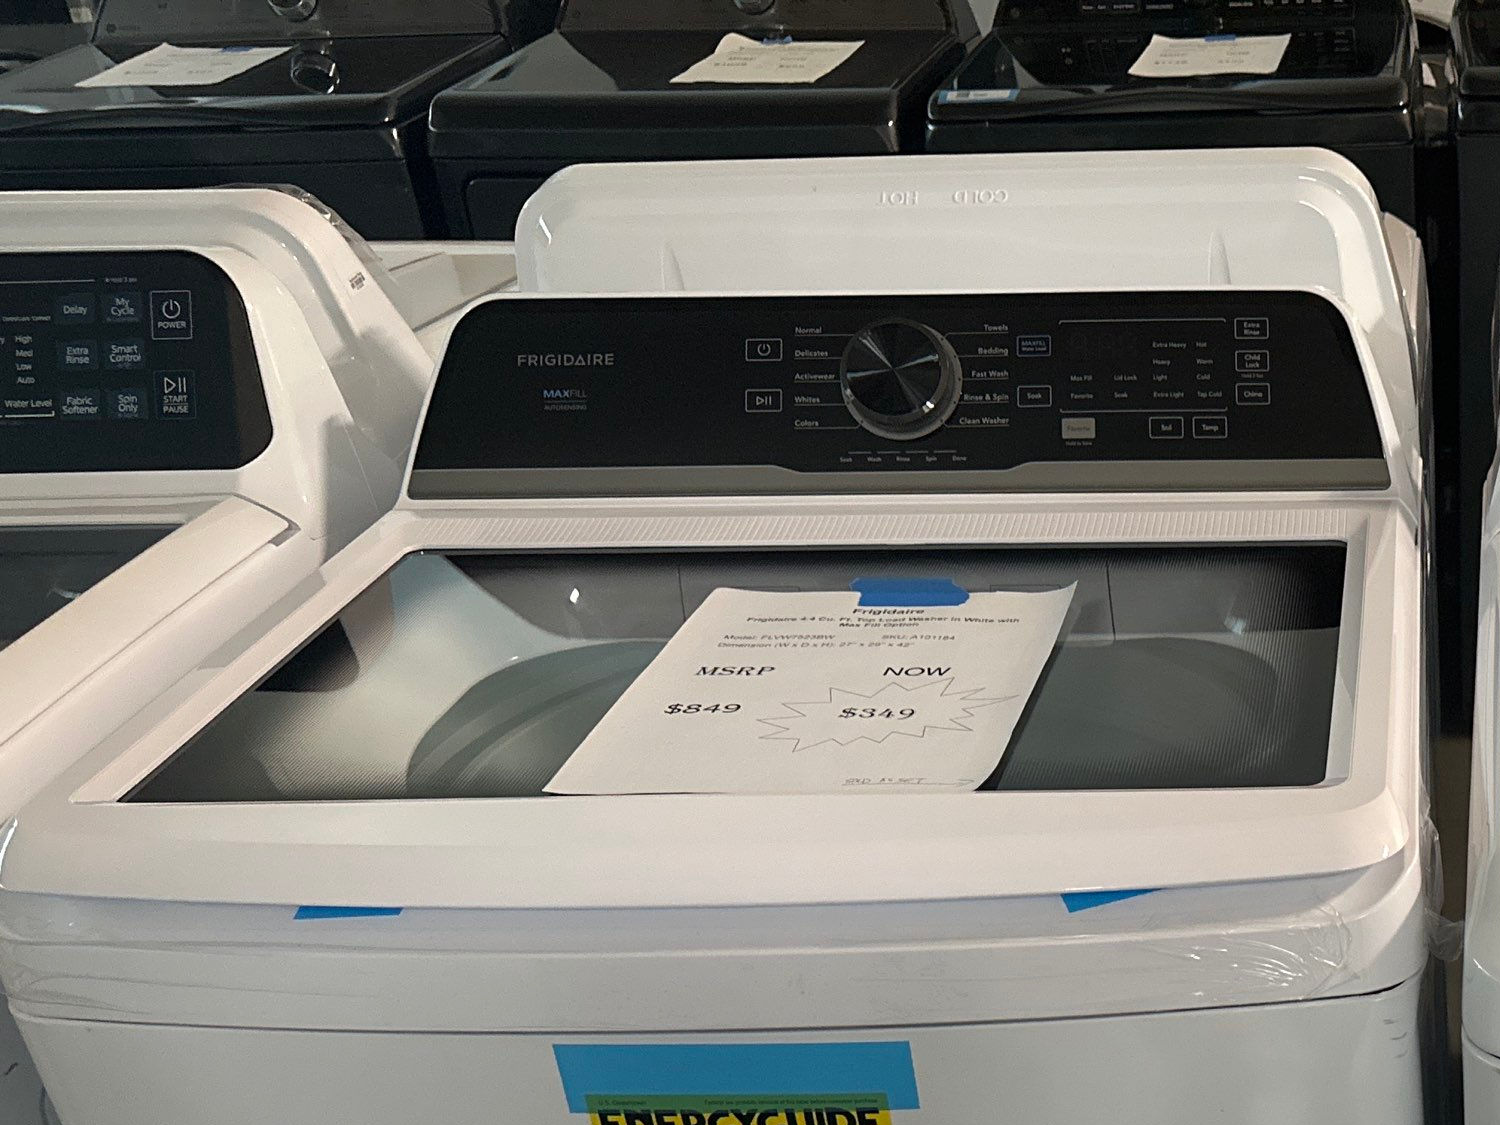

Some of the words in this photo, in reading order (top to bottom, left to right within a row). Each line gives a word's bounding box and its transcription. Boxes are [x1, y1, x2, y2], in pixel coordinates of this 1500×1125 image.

[953, 189, 1008, 204] COLD
[115, 298, 130, 307] My
[63, 305, 88, 315] Delay
[111, 307, 135, 316] Cycle
[158, 321, 187, 329] POWER
[795, 326, 822, 334] Normal
[15, 335, 33, 344] High
[111, 345, 138, 354] Smart
[1169, 341, 1187, 349] Heavy
[66, 347, 89, 355] Extra
[795, 349, 828, 357] Delicates
[978, 347, 1009, 355] Bedding
[65, 356, 90, 364] Rinse
[109, 354, 142, 363] Control
[517, 353, 614, 367] FRIGIDAIRE
[16, 363, 32, 371] Low
[794, 372, 836, 380] Activewear
[543, 389, 587, 398] MAXFILL
[964, 393, 982, 401] Rinse
[992, 393, 1009, 402] Spin
[1170, 391, 1185, 399] Light
[30, 399, 53, 407] Level
[66, 396, 93, 405] Fabric
[118, 394, 138, 405] Spin
[163, 395, 188, 403] START
[62, 405, 98, 415] Softener
[118, 404, 138, 414] Only
[162, 405, 189, 414] PAUSE
[959, 417, 980, 425] Clean
[981, 417, 1010, 425] Washer
[853, 608, 925, 616] Frigidaire
[694, 664, 777, 677] MSRP
[882, 666, 952, 677] NOW
[663, 702, 742, 716] $849
[838, 705, 917, 720] $349
